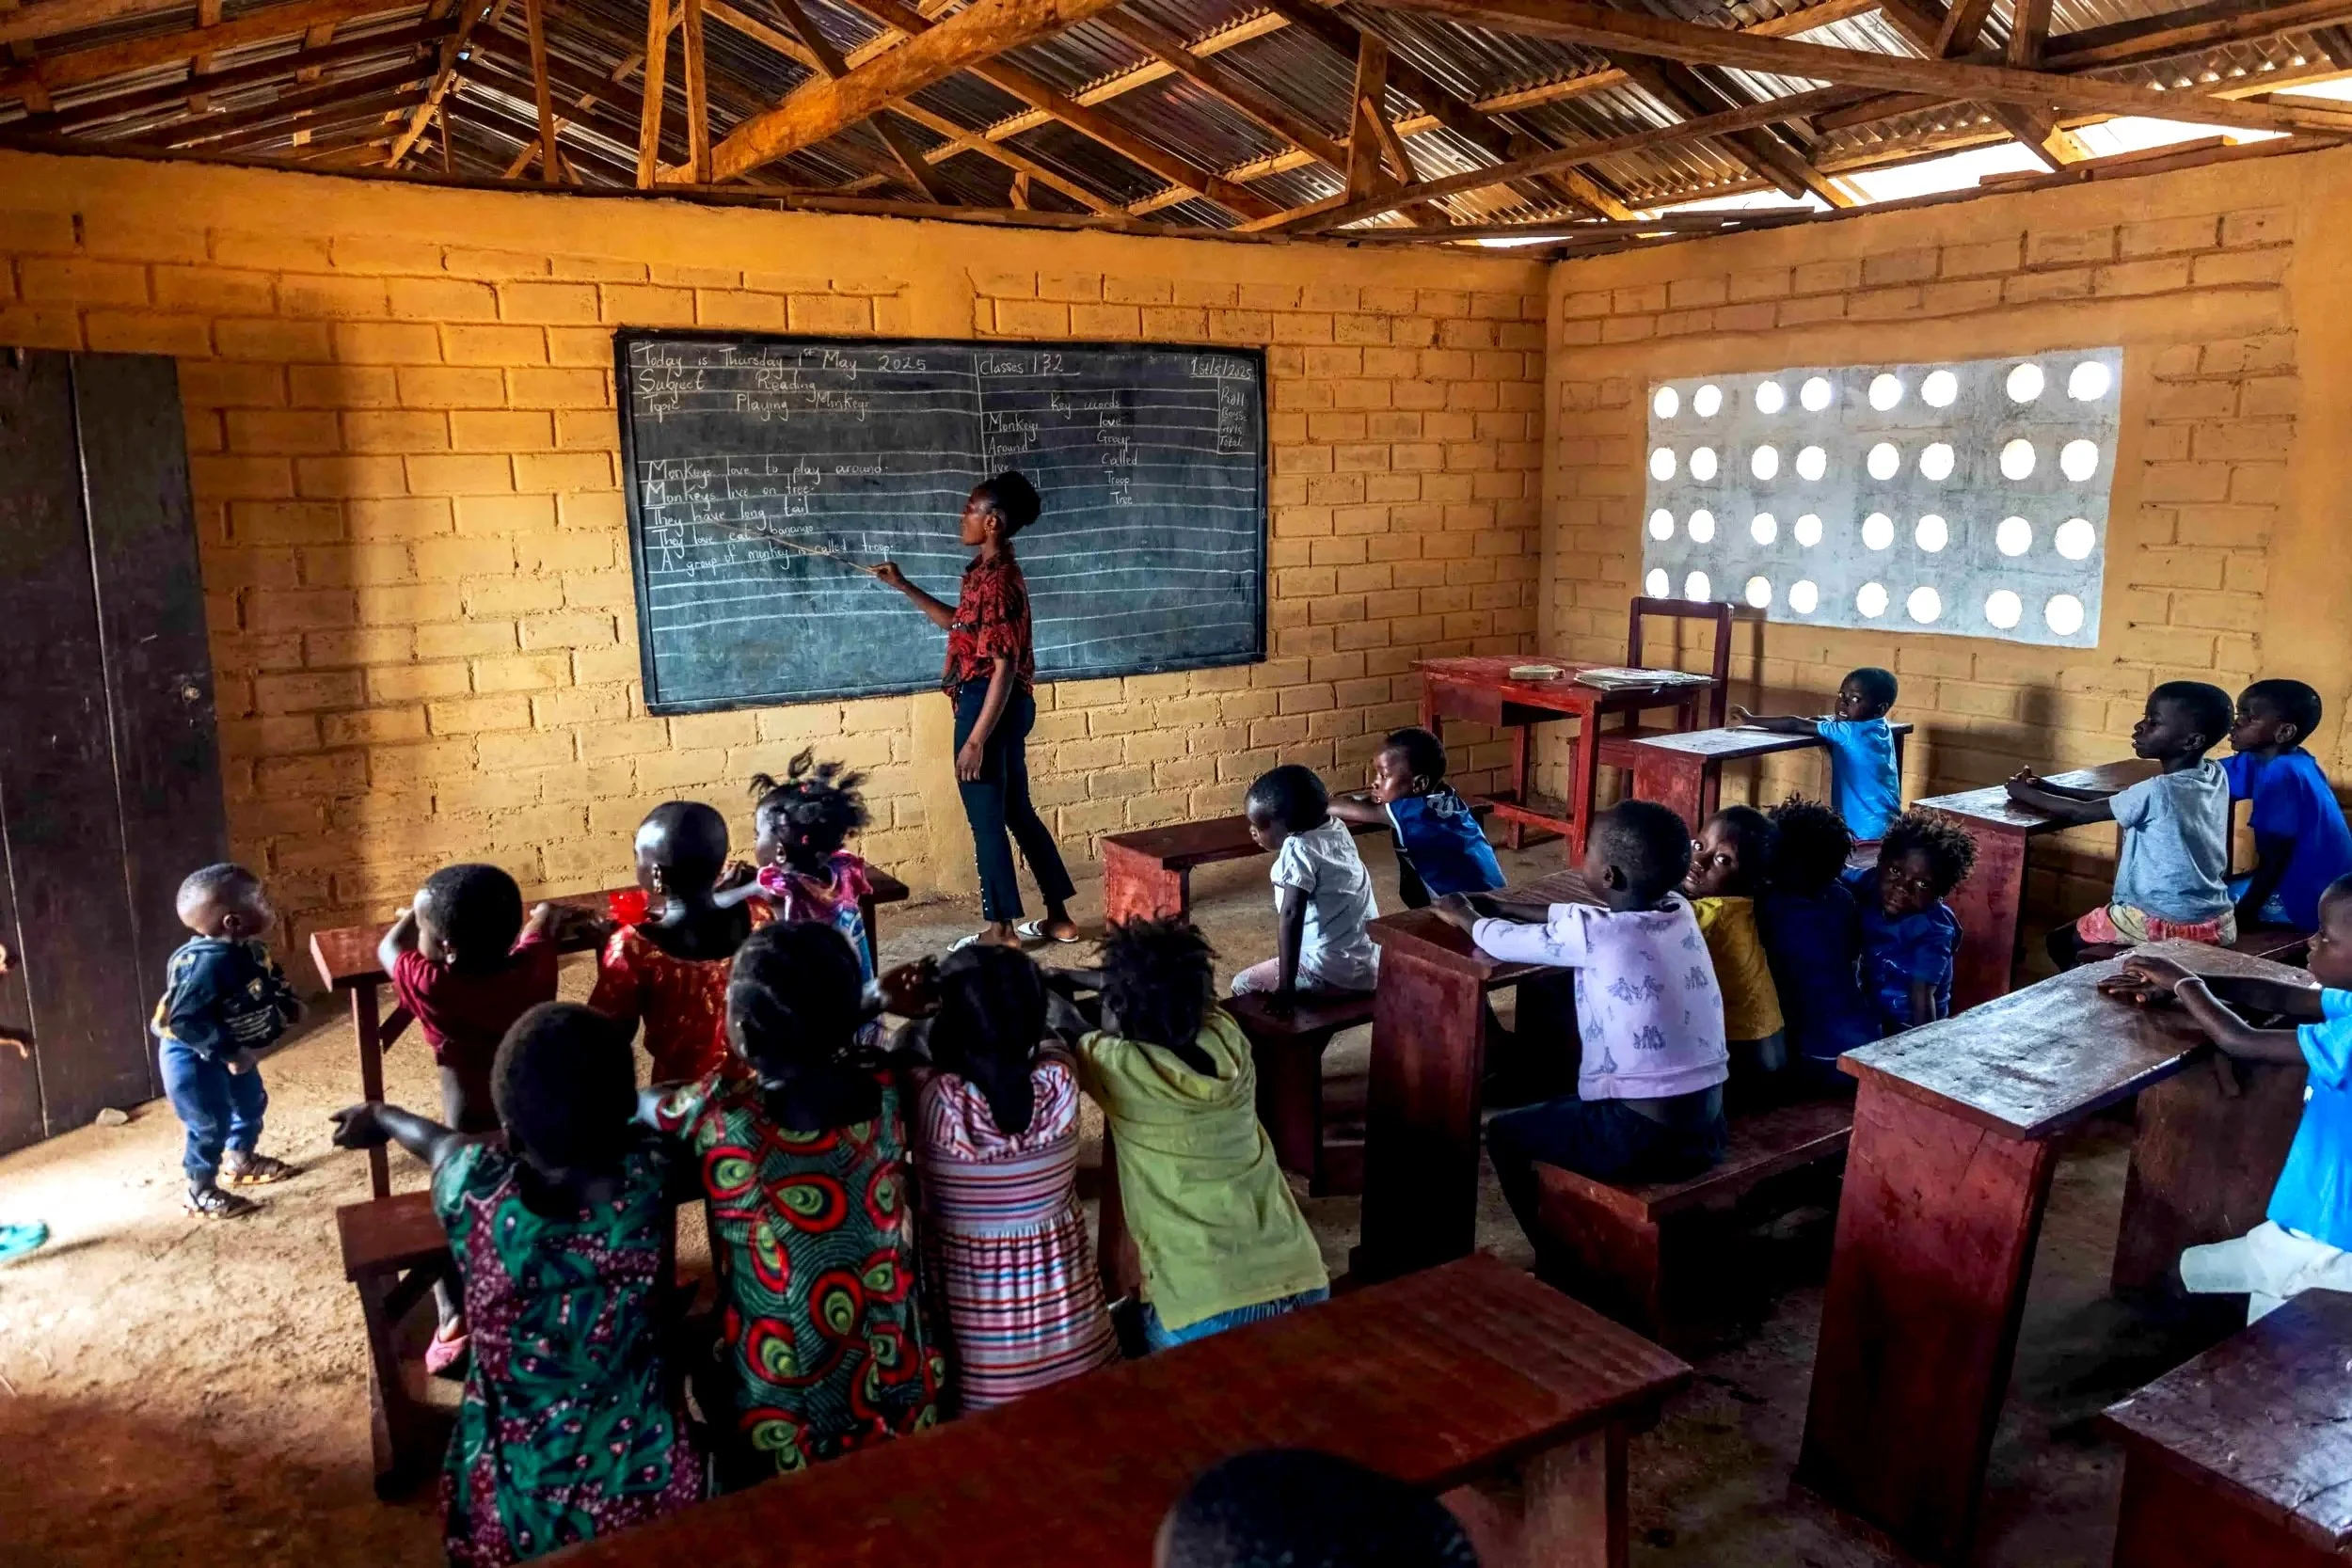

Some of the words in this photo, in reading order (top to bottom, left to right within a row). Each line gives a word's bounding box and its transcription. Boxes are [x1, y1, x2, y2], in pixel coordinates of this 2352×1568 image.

[632, 344, 682, 376] Today
[698, 356, 708, 366] is
[719, 347, 783, 379] Thursday
[822, 350, 857, 380] May
[878, 355, 927, 372] 2025
[980, 354, 1024, 374] Classes
[639, 368, 705, 403] Subject
[755, 368, 816, 402] Reading
[1221, 387, 1244, 406] Roll
[643, 393, 680, 422] Topic
[737, 391, 788, 421] Playing
[1051, 393, 1071, 420] Key
[1084, 390, 1120, 410] words
[1100, 411, 1121, 428] love
[989, 433, 1027, 456] Around
[1097, 430, 1130, 451] Group
[726, 455, 750, 476] love
[766, 454, 778, 475] to
[793, 456, 820, 484] play
[1102, 448, 1137, 466] Called
[646, 480, 715, 511] Monkeys
[726, 475, 749, 499] live
[1104, 470, 1130, 494] Troop
[1110, 491, 1133, 505] Tree
[644, 506, 684, 537] They
[691, 503, 724, 524] have
[741, 500, 767, 531] long
[784, 496, 808, 516] tail
[651, 529, 684, 559] They
[693, 525, 713, 545] love
[661, 547, 674, 571] A
[686, 557, 717, 577] group
[724, 545, 738, 564] of
[815, 538, 846, 556] called
